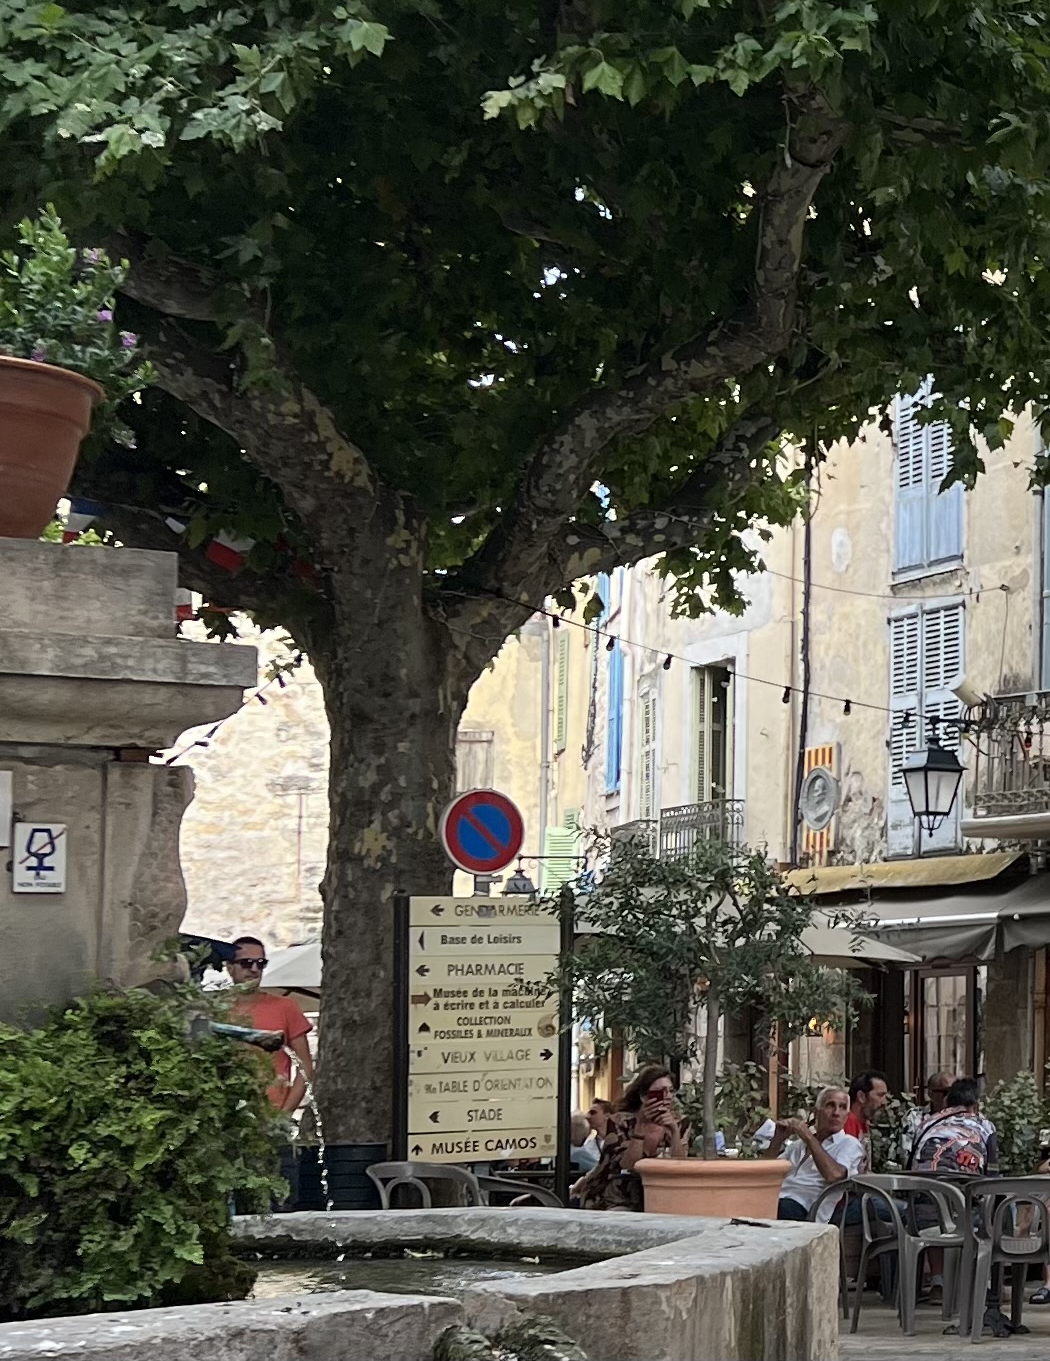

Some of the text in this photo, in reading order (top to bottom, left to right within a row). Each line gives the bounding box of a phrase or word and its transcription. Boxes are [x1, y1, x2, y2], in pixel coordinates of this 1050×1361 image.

[455, 904, 540, 916] GENARMERIE
[441, 935, 522, 944] Base de Loisirs
[447, 963, 524, 976] PHARMACIE
[433, 987, 468, 998] Musée
[472, 988, 485, 997] de
[488, 988, 498, 997] la
[444, 1001, 475, 1010] écrire
[480, 1000, 489, 1009] et
[503, 999, 545, 1009] calculer
[457, 1016, 511, 1026] COLLECTION
[434, 1030, 473, 1039] FOSSILES
[441, 1049, 531, 1063] VIEUX VILLAGE
[439, 1080, 468, 1093] TABLE
[467, 1108, 502, 1122] STADE
[431, 1137, 537, 1155] MUSÉE CAMOS
